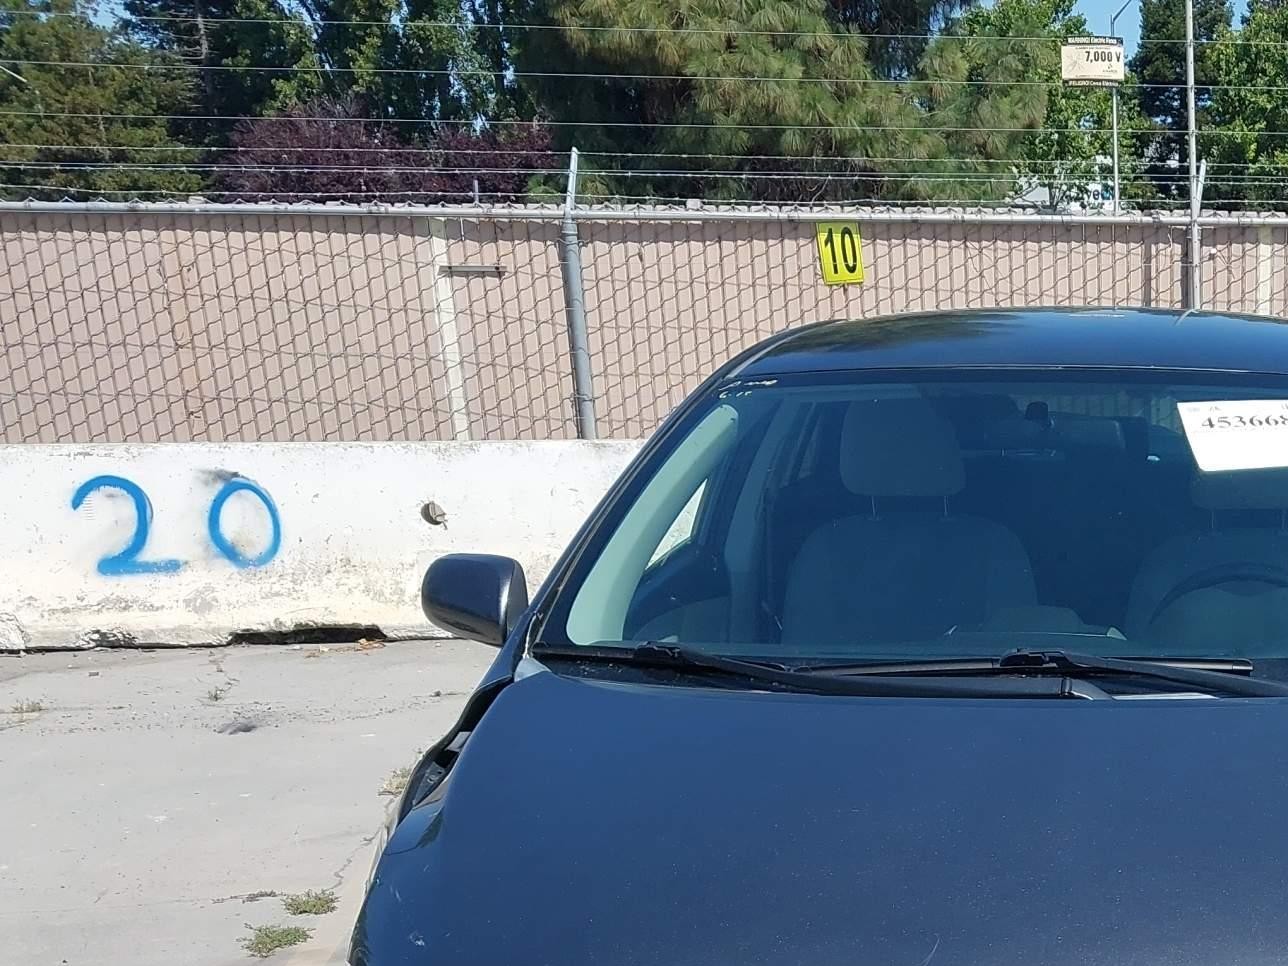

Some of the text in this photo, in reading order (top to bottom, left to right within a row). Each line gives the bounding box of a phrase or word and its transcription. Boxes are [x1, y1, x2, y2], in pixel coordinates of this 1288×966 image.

[1085, 51, 1121, 63] 7,000 V
[824, 227, 857, 274] 10
[72, 475, 281, 575] 20
